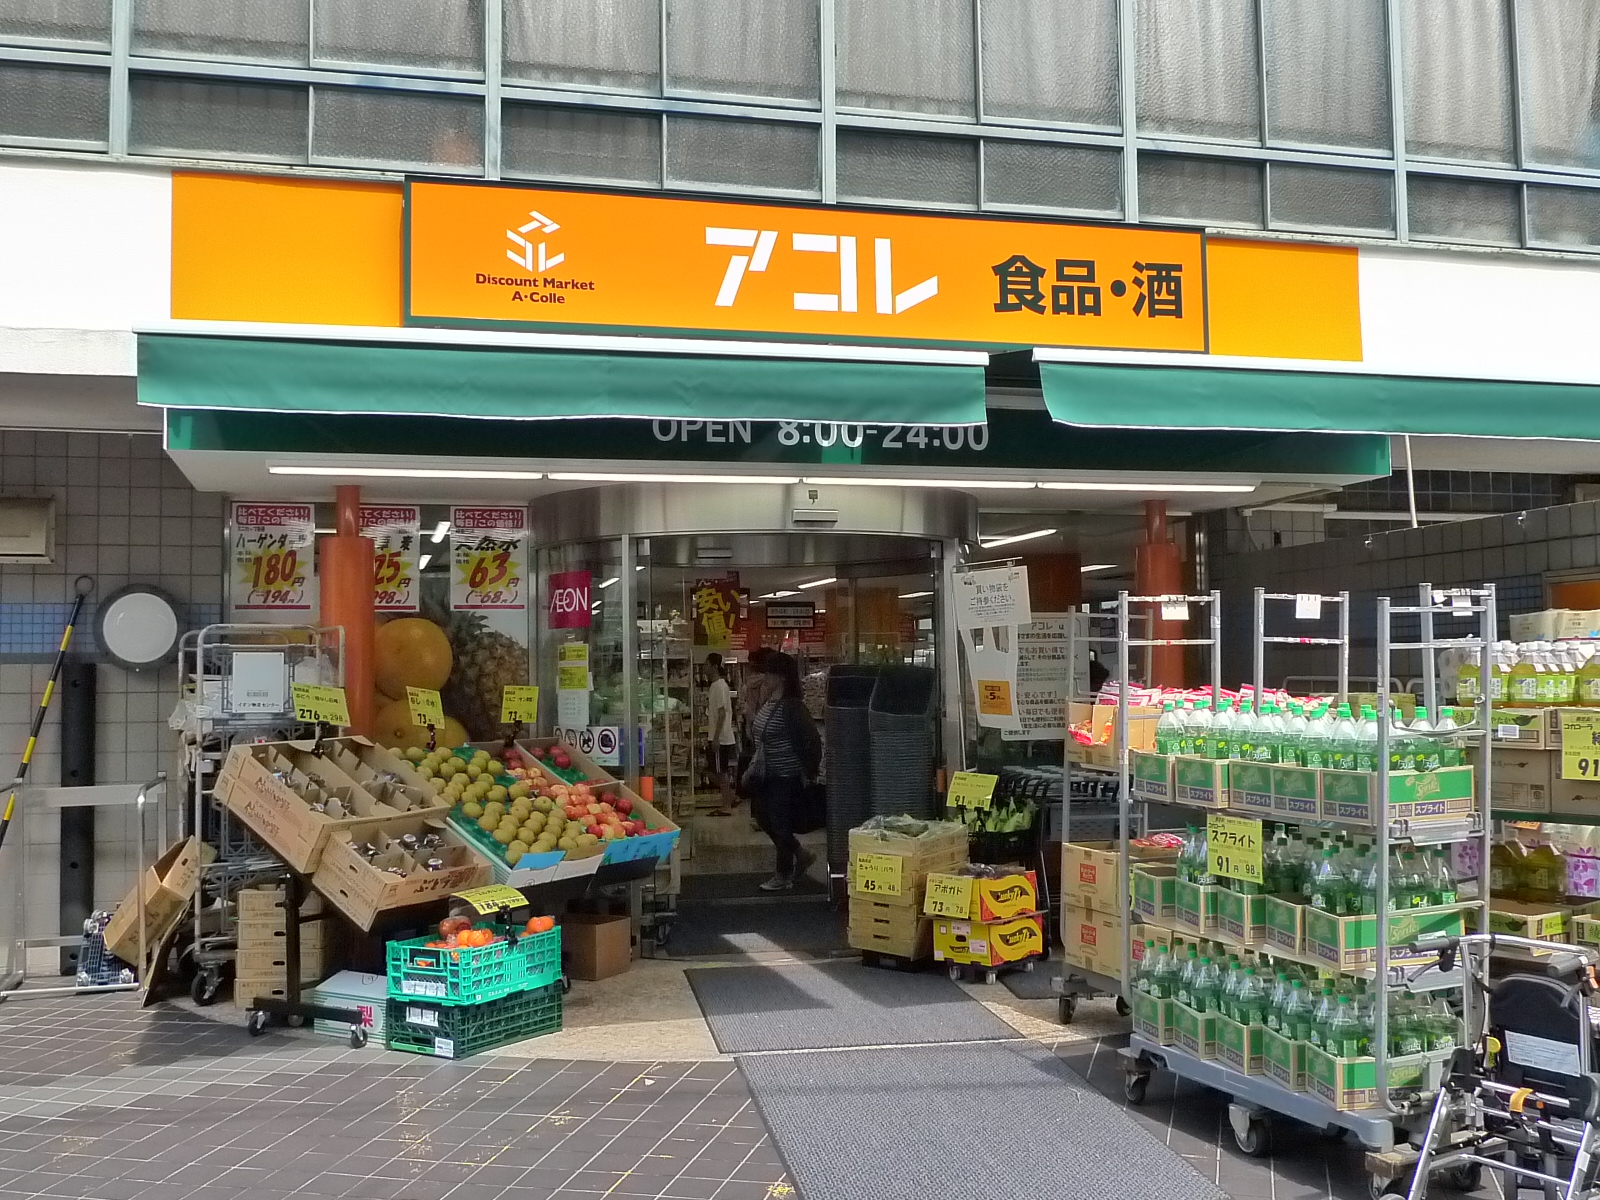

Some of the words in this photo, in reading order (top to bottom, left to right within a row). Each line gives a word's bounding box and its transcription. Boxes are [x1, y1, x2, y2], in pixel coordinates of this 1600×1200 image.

[705, 226, 938, 315] アコレ
[475, 273, 539, 288] Discount
[543, 277, 595, 291] Market
[991, 254, 1183, 319] 食品・酒
[652, 418, 752, 443] OPEN
[1339, 806, 1369, 818] スプライト
[1415, 803, 1445, 815] スプライト
